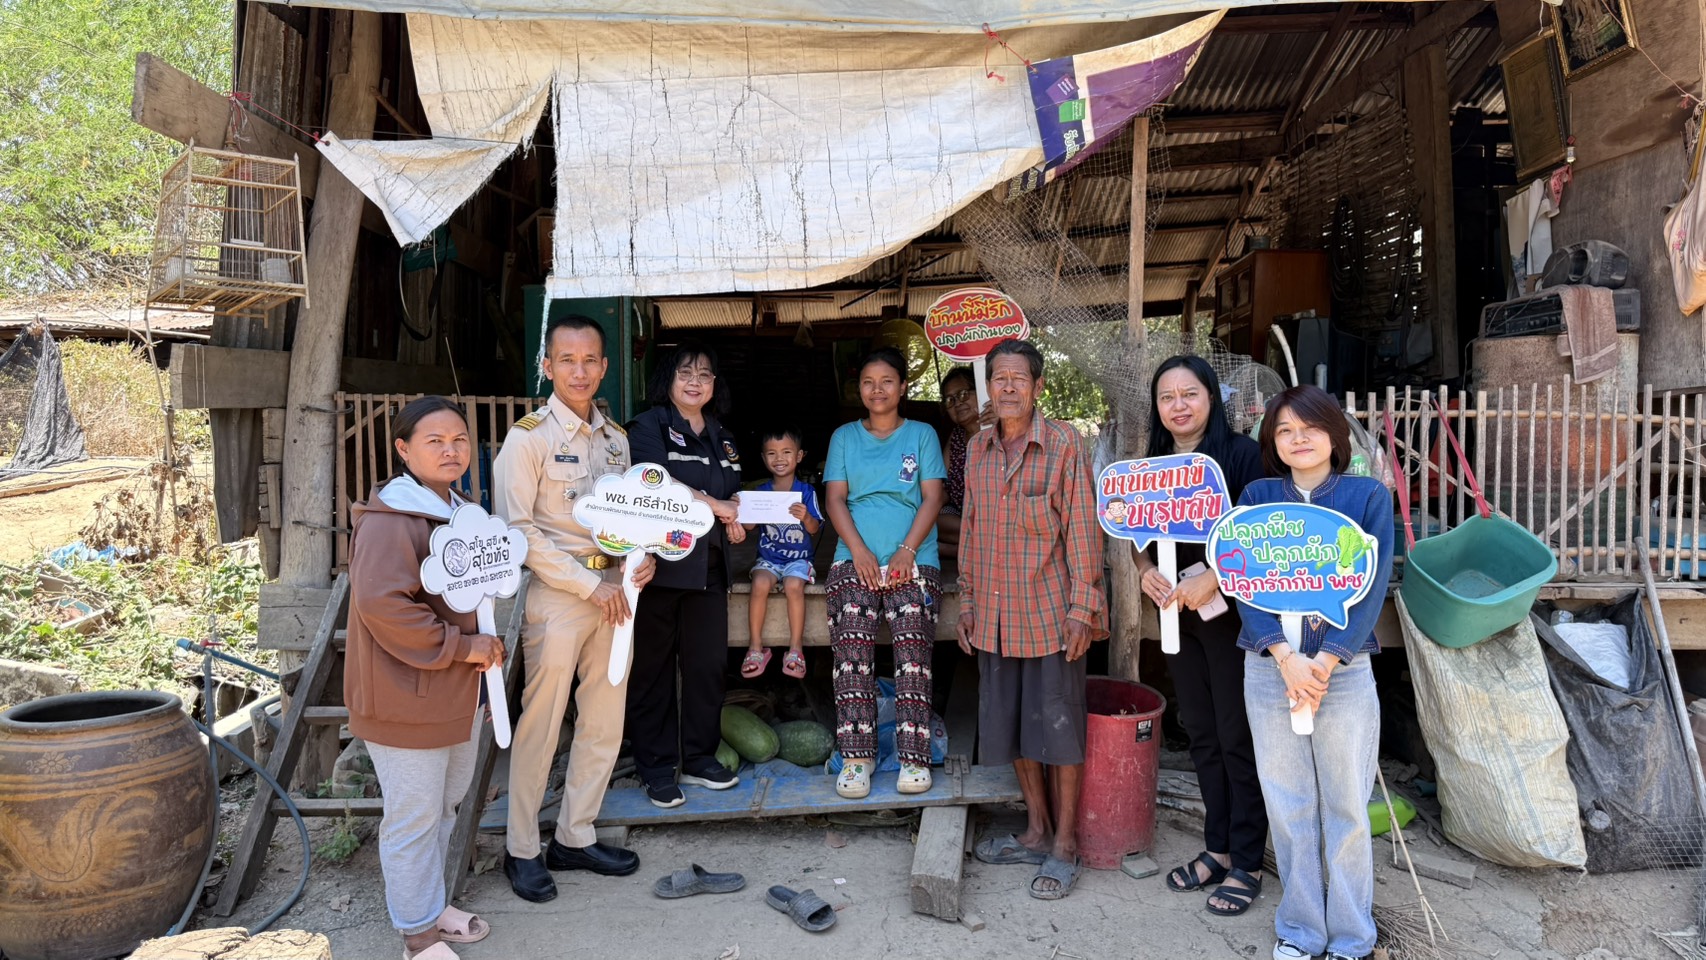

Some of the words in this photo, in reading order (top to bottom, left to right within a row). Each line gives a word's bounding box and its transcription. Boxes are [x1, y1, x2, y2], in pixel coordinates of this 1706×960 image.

[929, 295, 1013, 328] บ้านนี้มีรัก
[936, 323, 1020, 349] ปลูกผักกินเอง
[1102, 457, 1205, 496] บำบัดทุกข์
[605, 492, 628, 505] พช.
[633, 495, 688, 514] ศรีสำโรง
[1126, 486, 1223, 534] บำรุงสุข
[469, 535, 483, 553] สุโข
[1218, 511, 1305, 547] ปลูกพืช
[472, 546, 510, 571] สุโขทัย
[1253, 535, 1338, 571] ปลูกผัก
[1220, 568, 1323, 600] ปลูกรักกับ
[1327, 572, 1364, 590] พช
